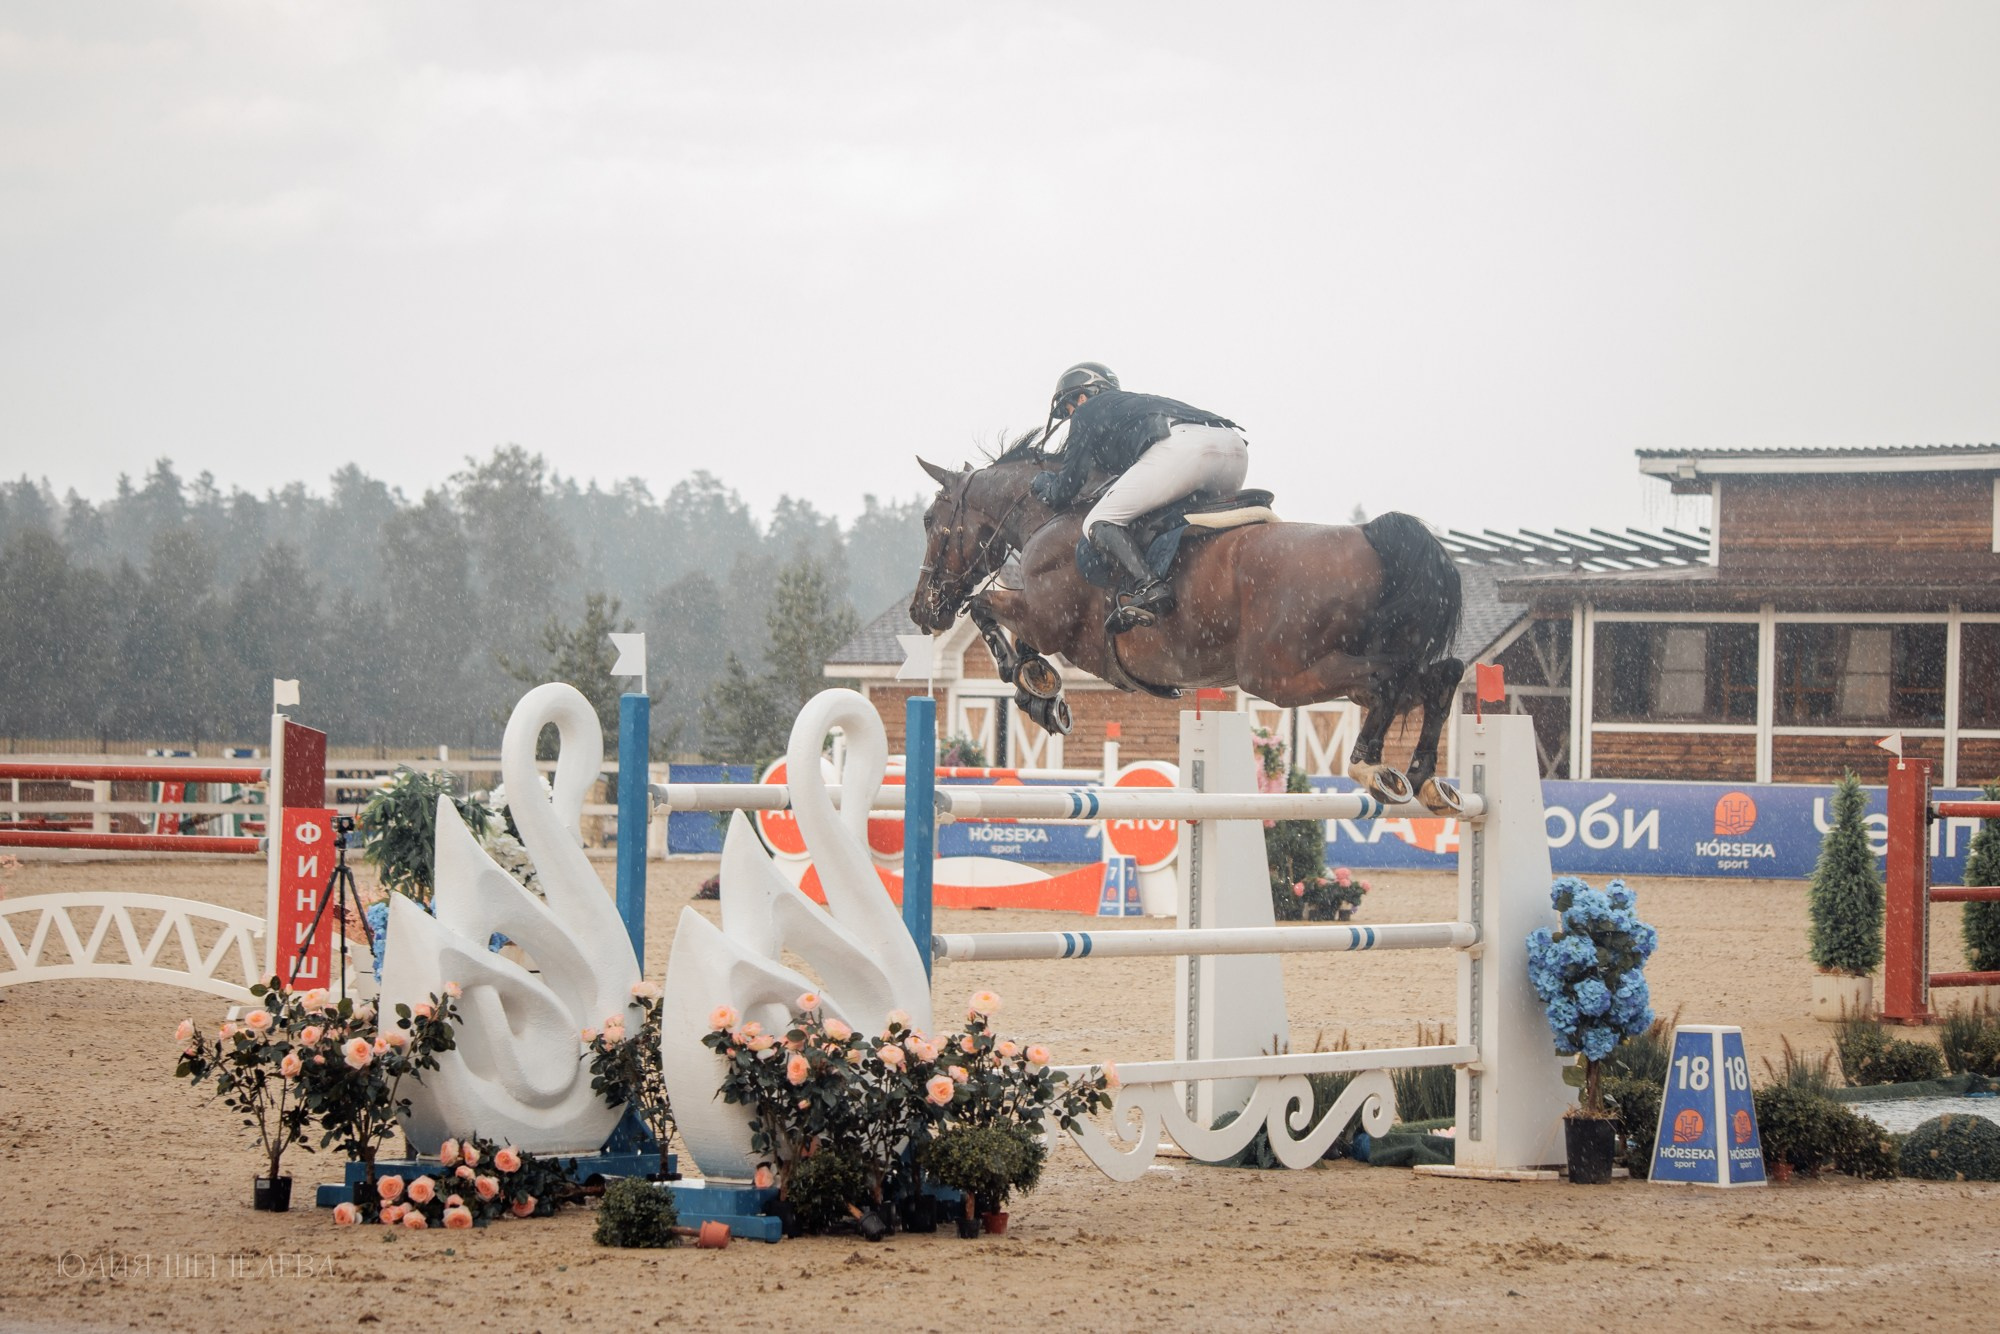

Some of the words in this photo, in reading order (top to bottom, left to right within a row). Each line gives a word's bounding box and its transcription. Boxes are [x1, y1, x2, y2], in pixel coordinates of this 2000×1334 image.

[968, 824, 1048, 842] HÓRSEKA
[990, 844, 1022, 854] sport
[1695, 839, 1776, 858] HÓRSEKA
[1717, 859, 1749, 870] sport
[1109, 866, 1118, 881] 7
[1127, 866, 1135, 881] 7
[288, 821, 322, 979] ФИНИШ
[1675, 1056, 1710, 1091] 18
[1725, 1056, 1748, 1091] 18
[1659, 1145, 1716, 1160] HÓRSEKA
[1674, 1161, 1696, 1169] sport
